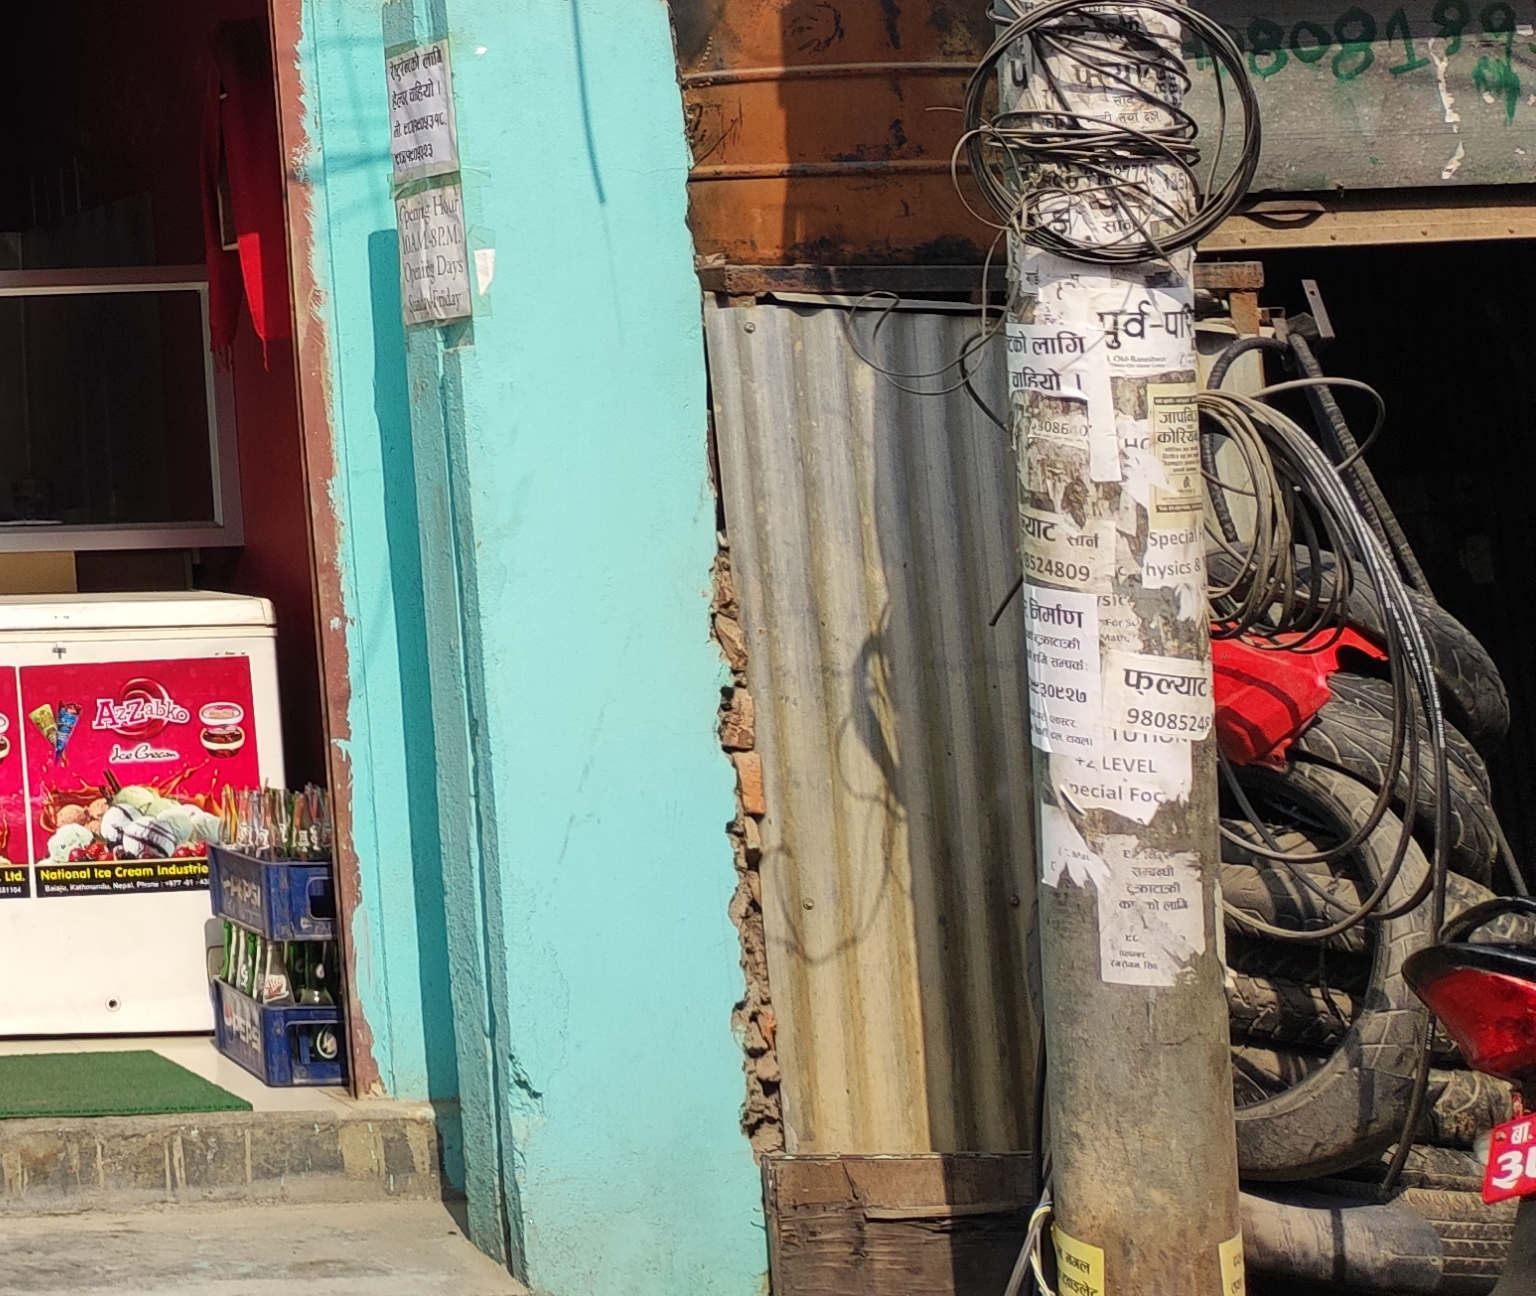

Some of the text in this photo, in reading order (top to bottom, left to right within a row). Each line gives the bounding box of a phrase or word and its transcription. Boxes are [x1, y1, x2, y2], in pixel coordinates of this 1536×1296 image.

[1146, 556, 1192, 579] hysics
[1102, 756, 1157, 774] LEVEL
[40, 868, 91, 881] National
[115, 866, 154, 878] Cream
[157, 862, 209, 875] Industrie
